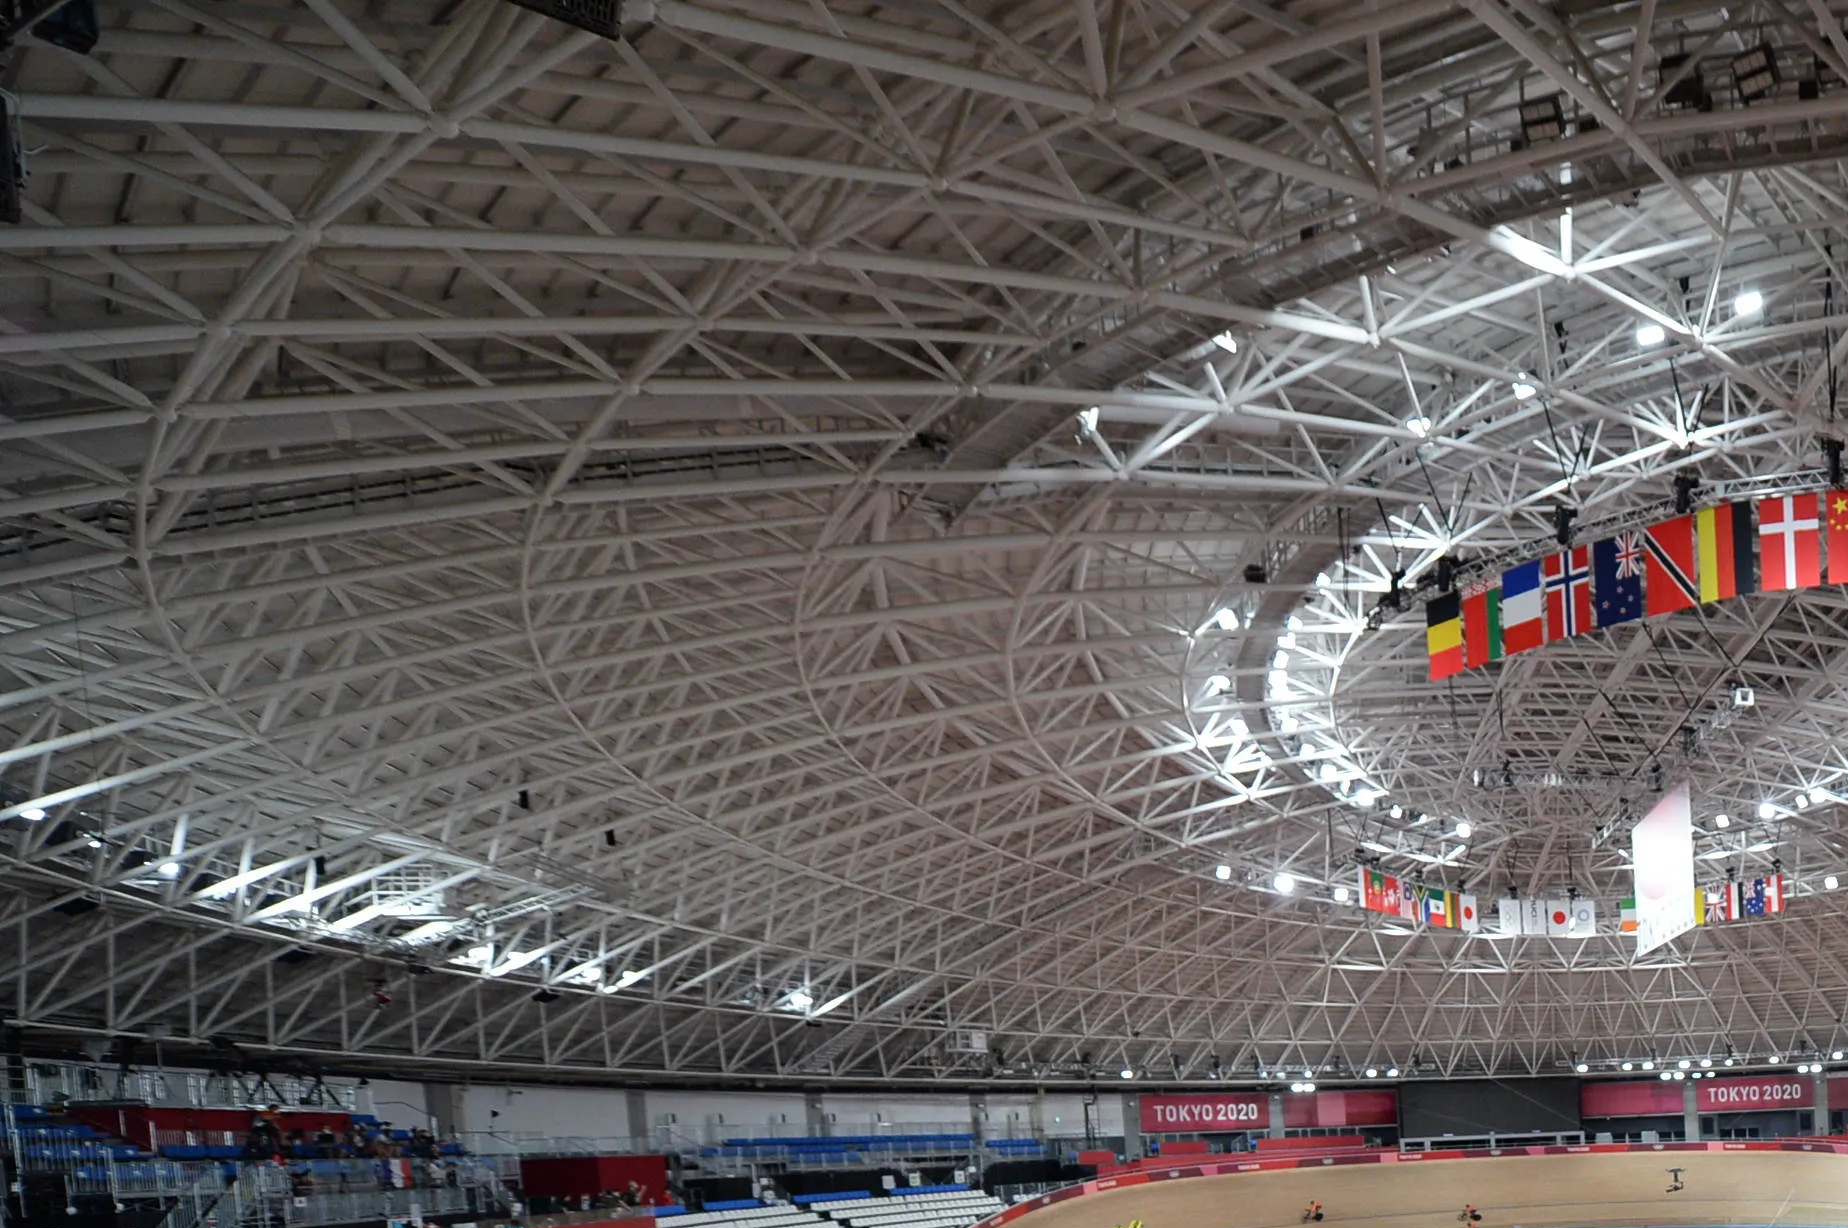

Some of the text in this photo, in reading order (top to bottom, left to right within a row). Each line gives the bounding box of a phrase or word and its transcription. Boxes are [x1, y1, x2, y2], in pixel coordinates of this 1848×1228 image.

[1708, 1083, 1801, 1103] TOKYO 2020
[1153, 1103, 1258, 1122] TOKYO 2020
